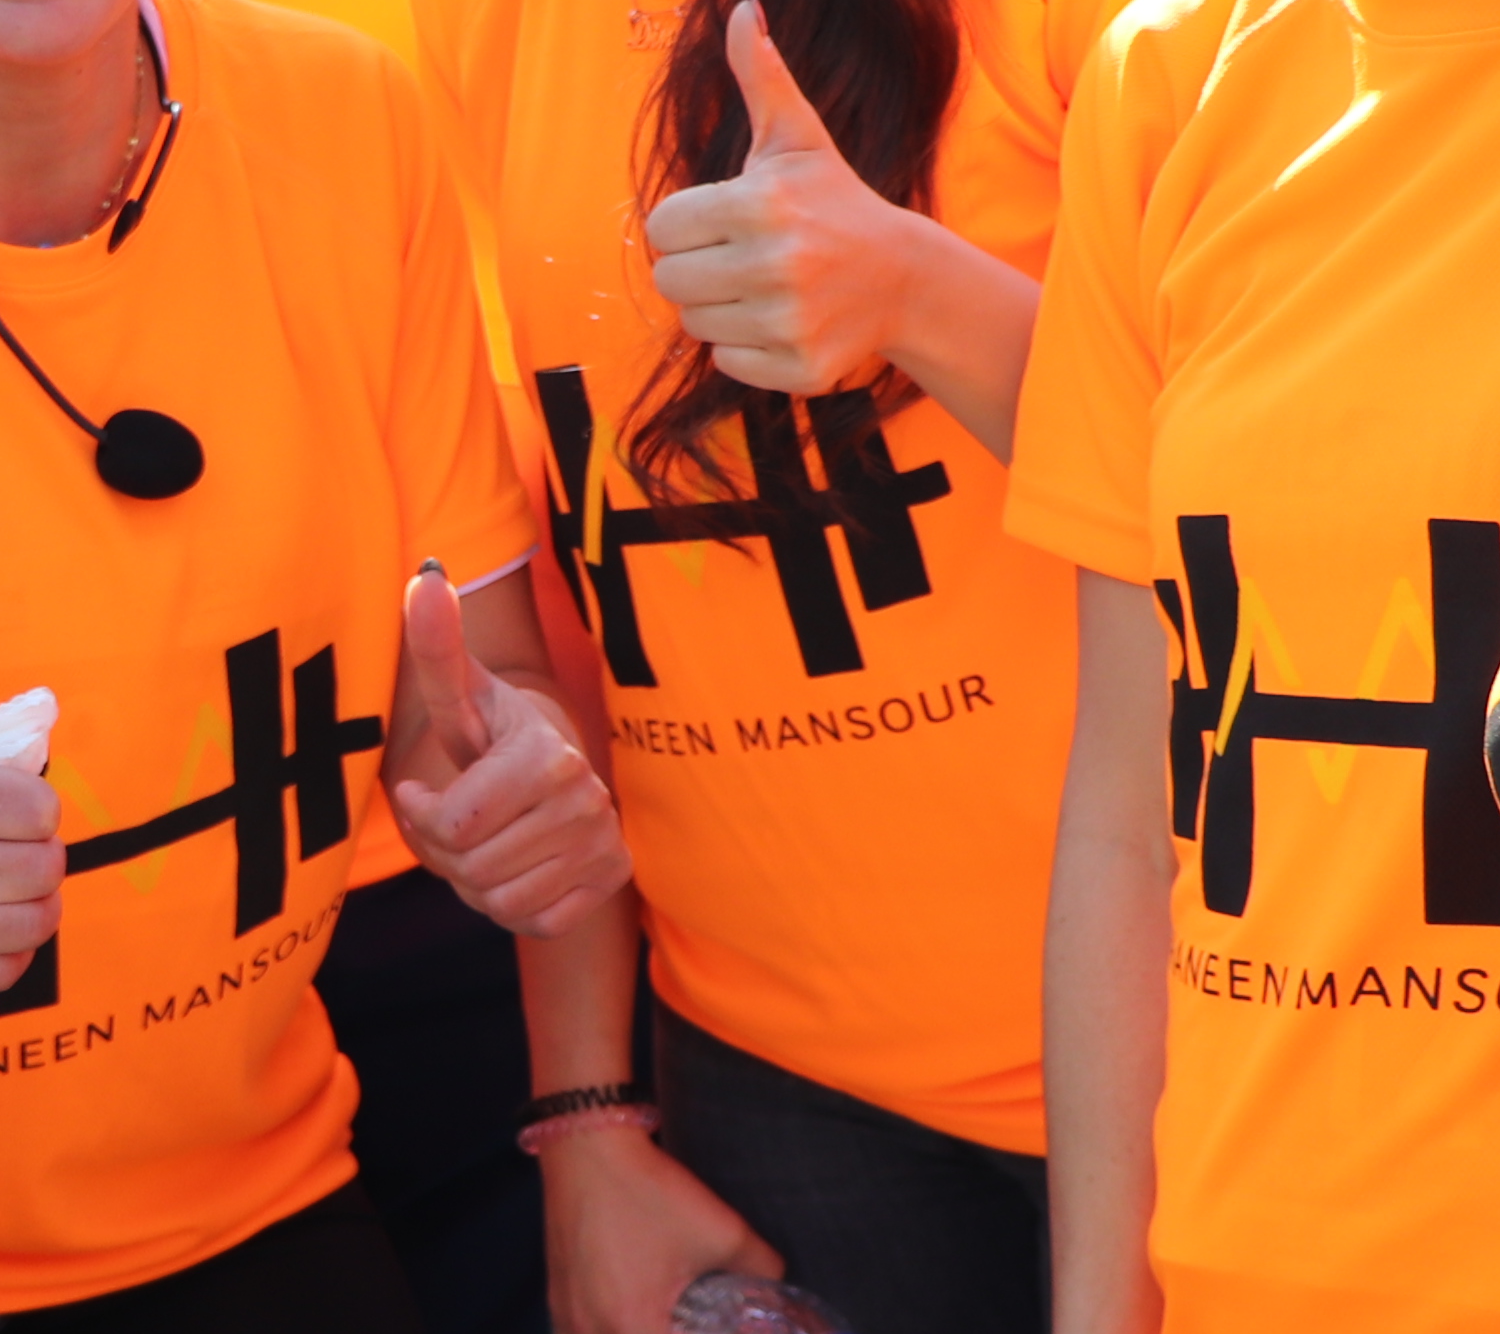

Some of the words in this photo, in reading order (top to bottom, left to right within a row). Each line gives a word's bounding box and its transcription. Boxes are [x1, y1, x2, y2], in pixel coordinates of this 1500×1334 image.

[734, 674, 996, 753] MANSOUR
[142, 890, 347, 1031] MANSOUR
[1170, 939, 1288, 1008] ANEEN
